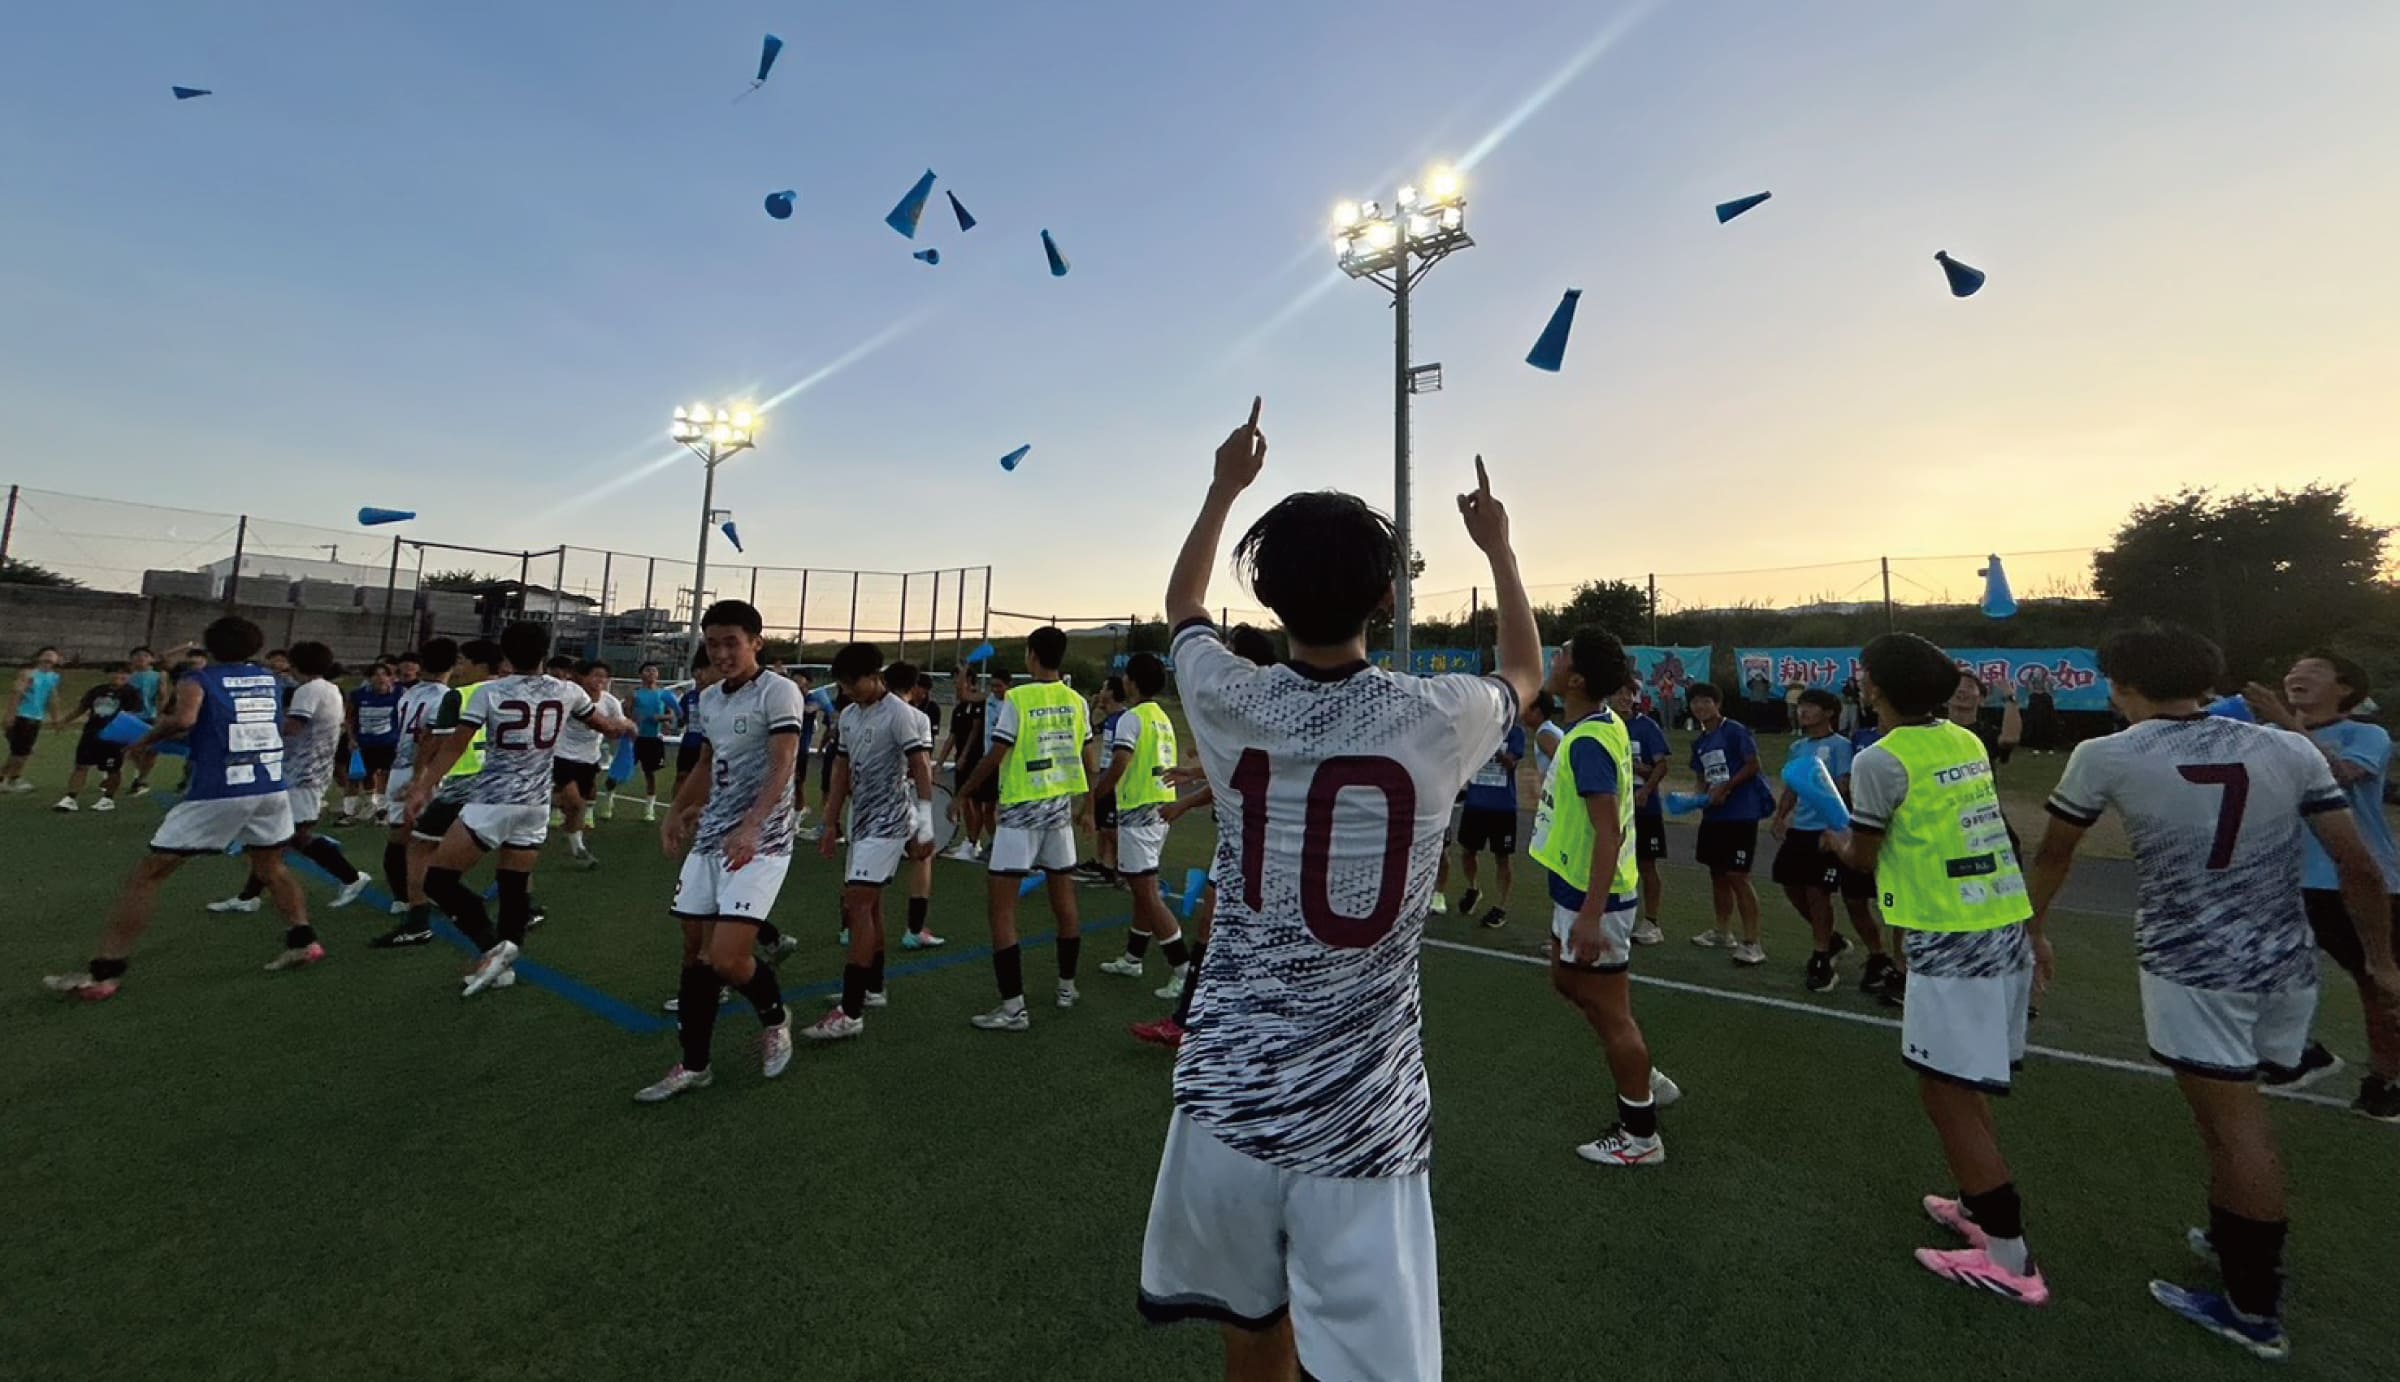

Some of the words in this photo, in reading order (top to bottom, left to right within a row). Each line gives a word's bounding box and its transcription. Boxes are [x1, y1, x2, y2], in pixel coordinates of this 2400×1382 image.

[400, 700, 426, 736] 14
[499, 700, 564, 750] 20
[716, 759, 729, 787] 2
[2176, 763, 2249, 869] 7
[1230, 747, 1416, 948] 10
[1884, 892, 1894, 908] 8
